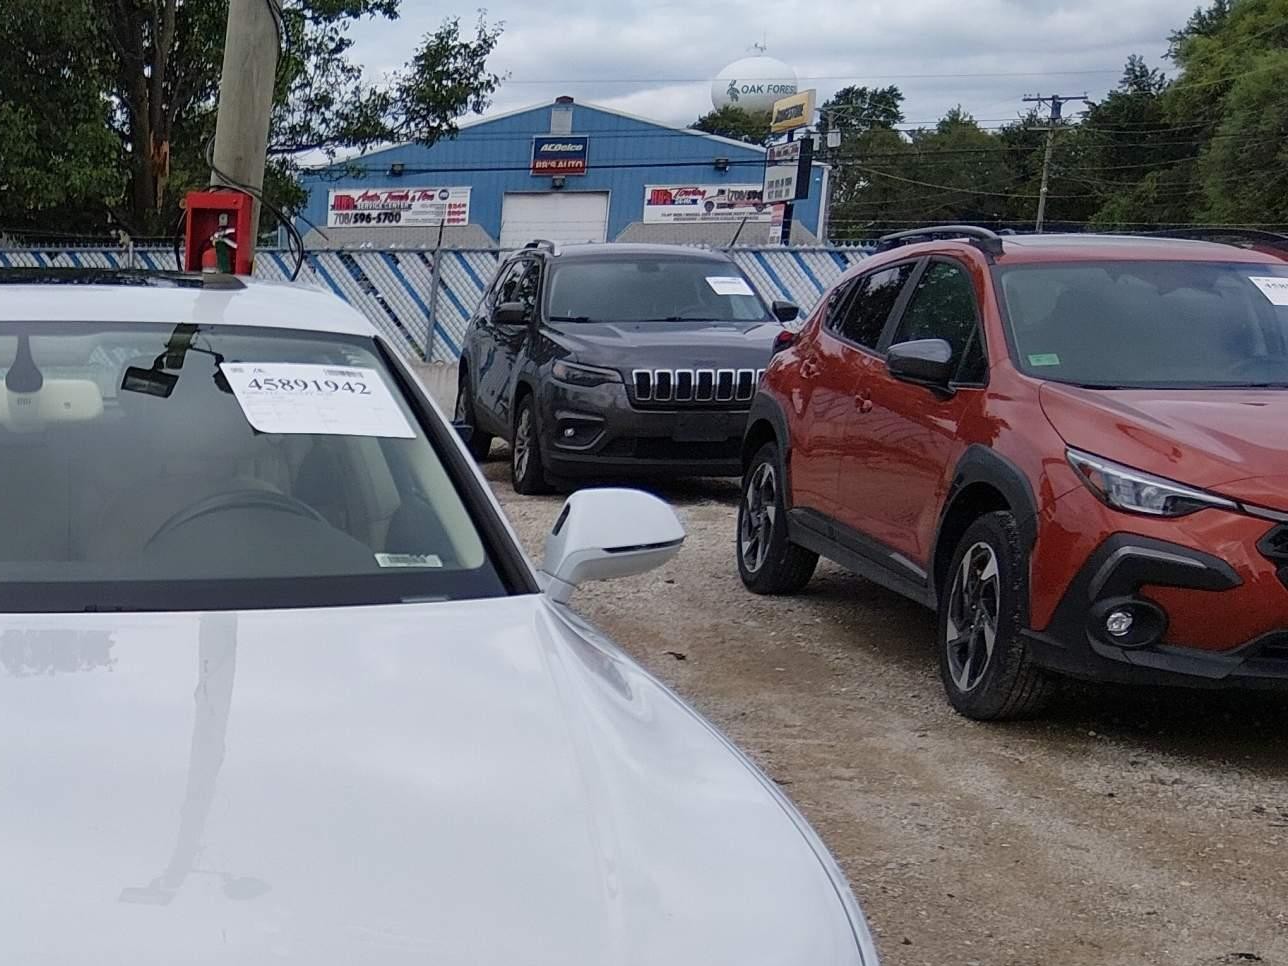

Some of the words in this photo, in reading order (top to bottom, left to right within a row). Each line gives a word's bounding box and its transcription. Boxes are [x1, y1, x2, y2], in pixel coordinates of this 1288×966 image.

[740, 84, 764, 94] OAK
[540, 143, 584, 152] ACDelco
[247, 377, 372, 396] 45891942
